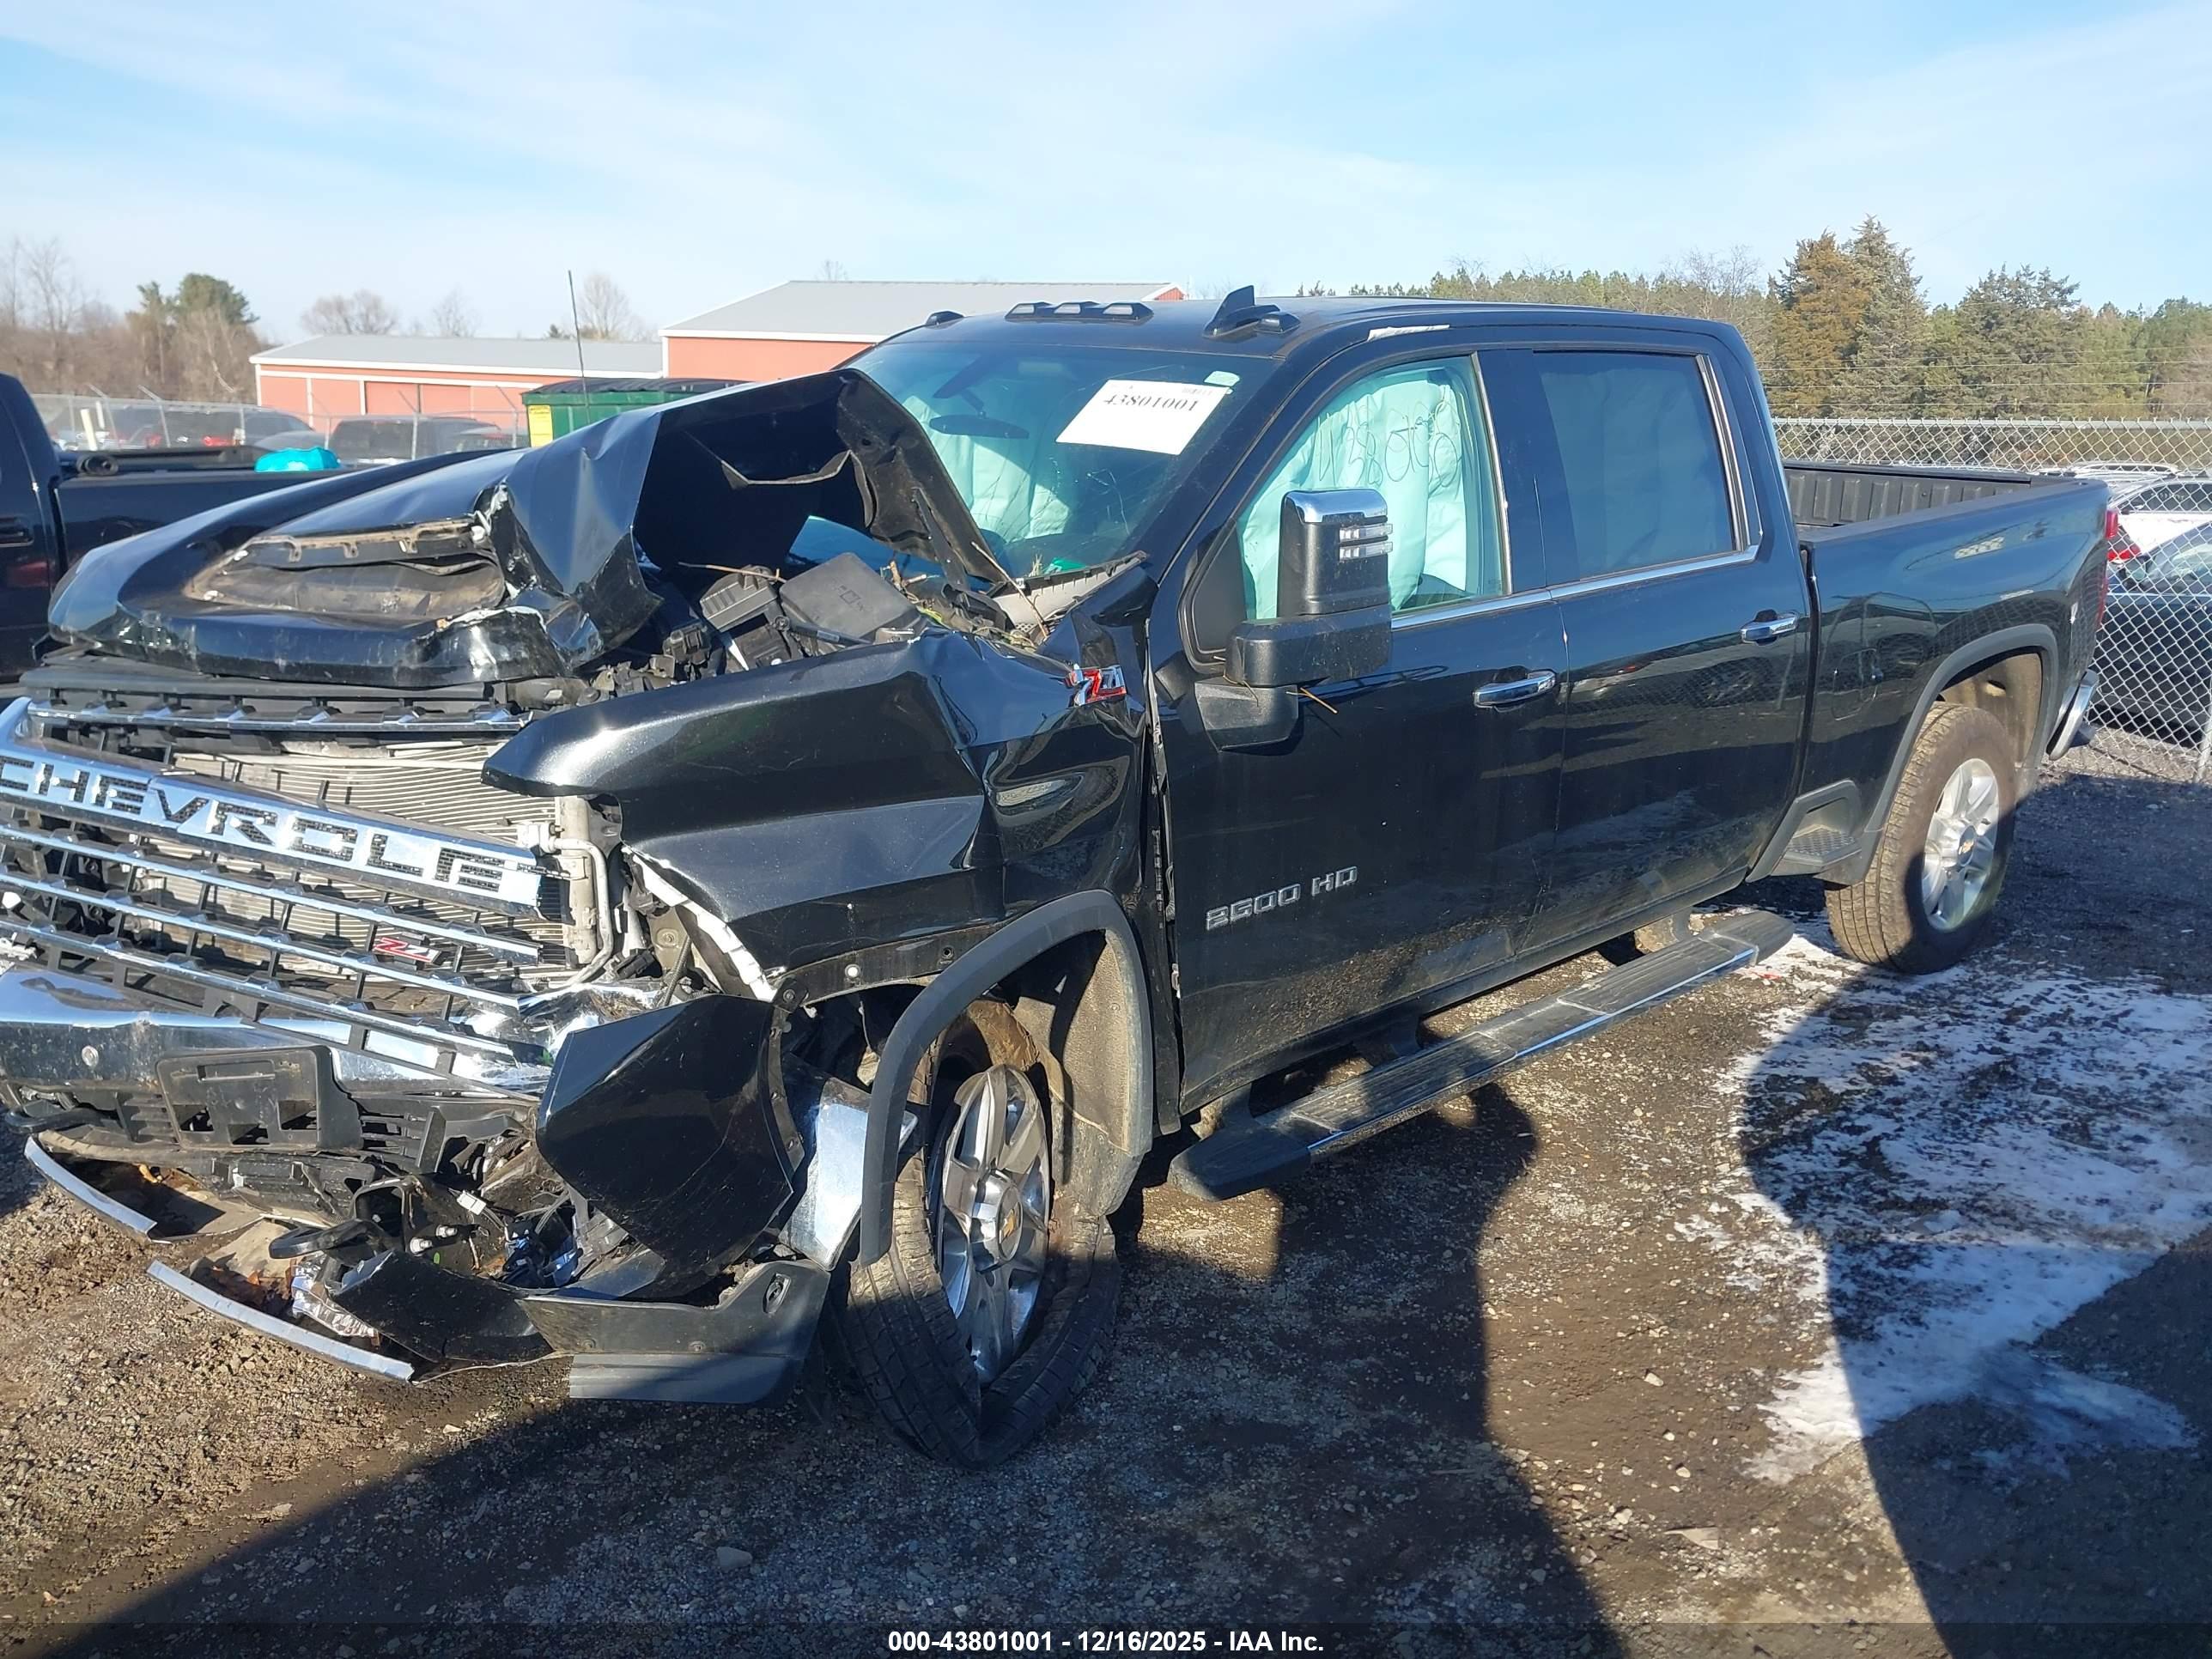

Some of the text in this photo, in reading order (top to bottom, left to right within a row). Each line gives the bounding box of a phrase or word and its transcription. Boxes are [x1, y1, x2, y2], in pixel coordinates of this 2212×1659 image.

[1103, 393, 1200, 412] 43801001
[1206, 866, 1359, 932] 2500 HD
